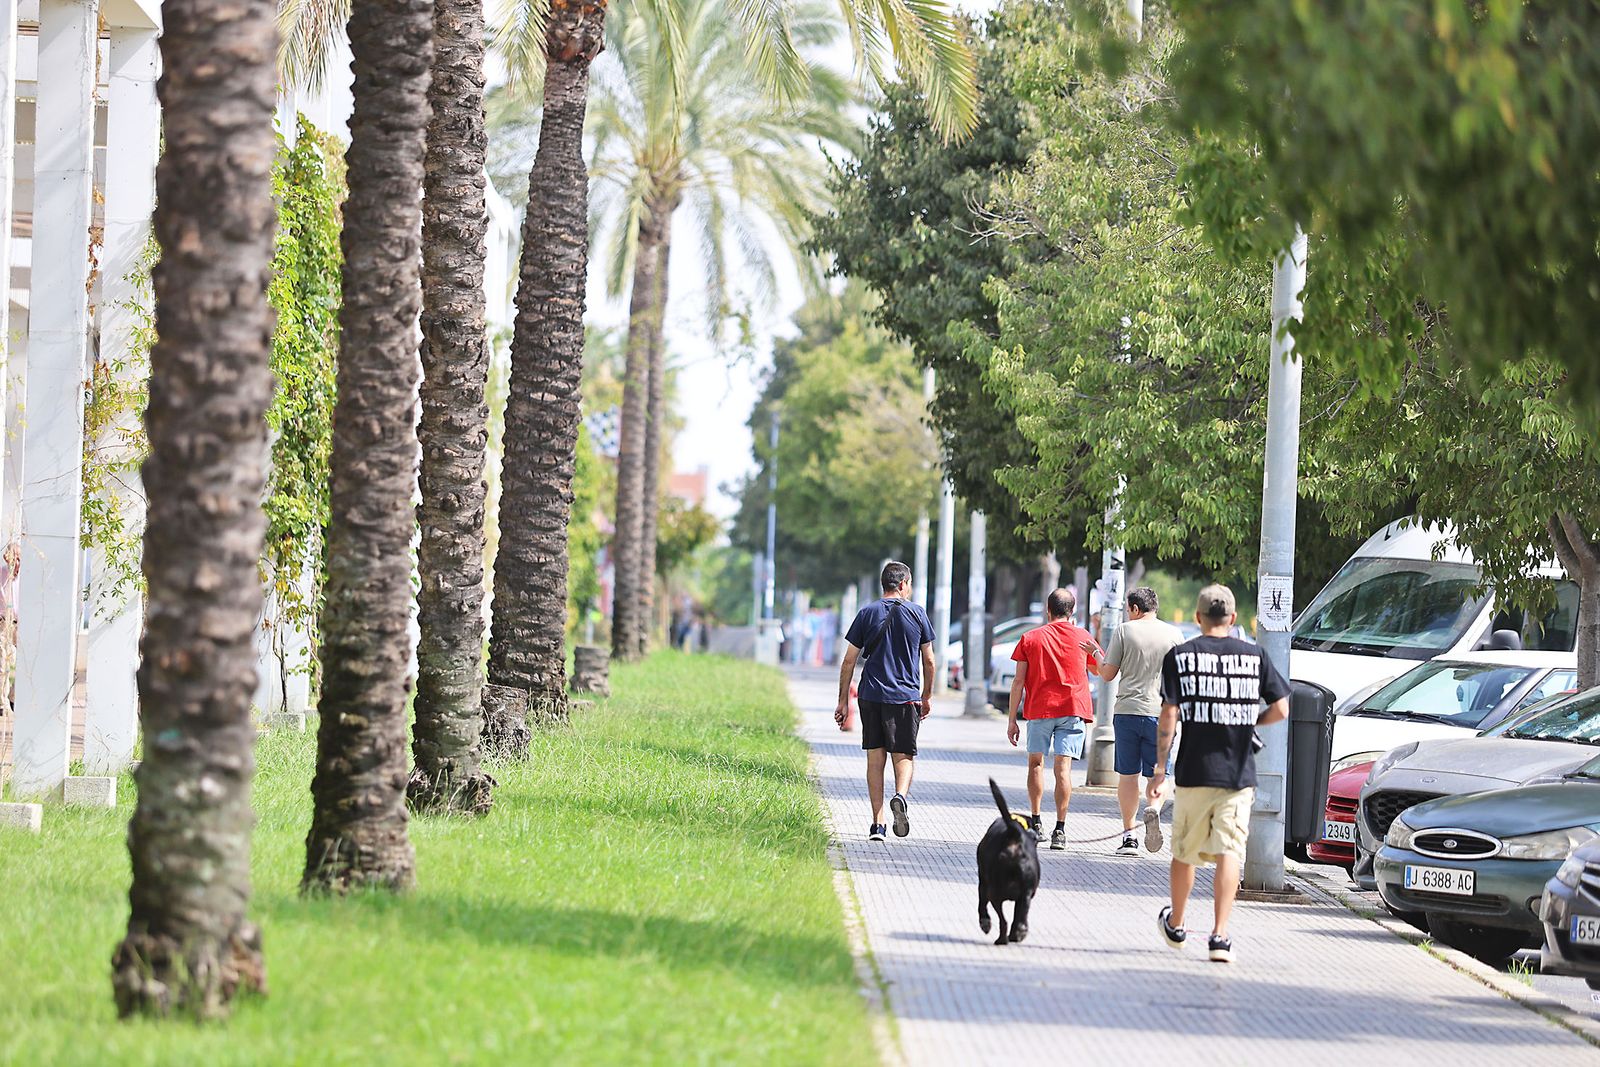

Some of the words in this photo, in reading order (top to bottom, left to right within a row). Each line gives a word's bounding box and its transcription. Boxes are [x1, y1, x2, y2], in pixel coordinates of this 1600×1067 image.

[1175, 652, 1196, 673] IT'S
[1197, 652, 1219, 674] NOT
[1220, 654, 1261, 676] TALENT
[1198, 675, 1228, 699] HARD
[1229, 677, 1260, 700] WORK
[1193, 701, 1210, 723] AN
[1327, 823, 1351, 840] 2349
[1457, 873, 1472, 891] AC
